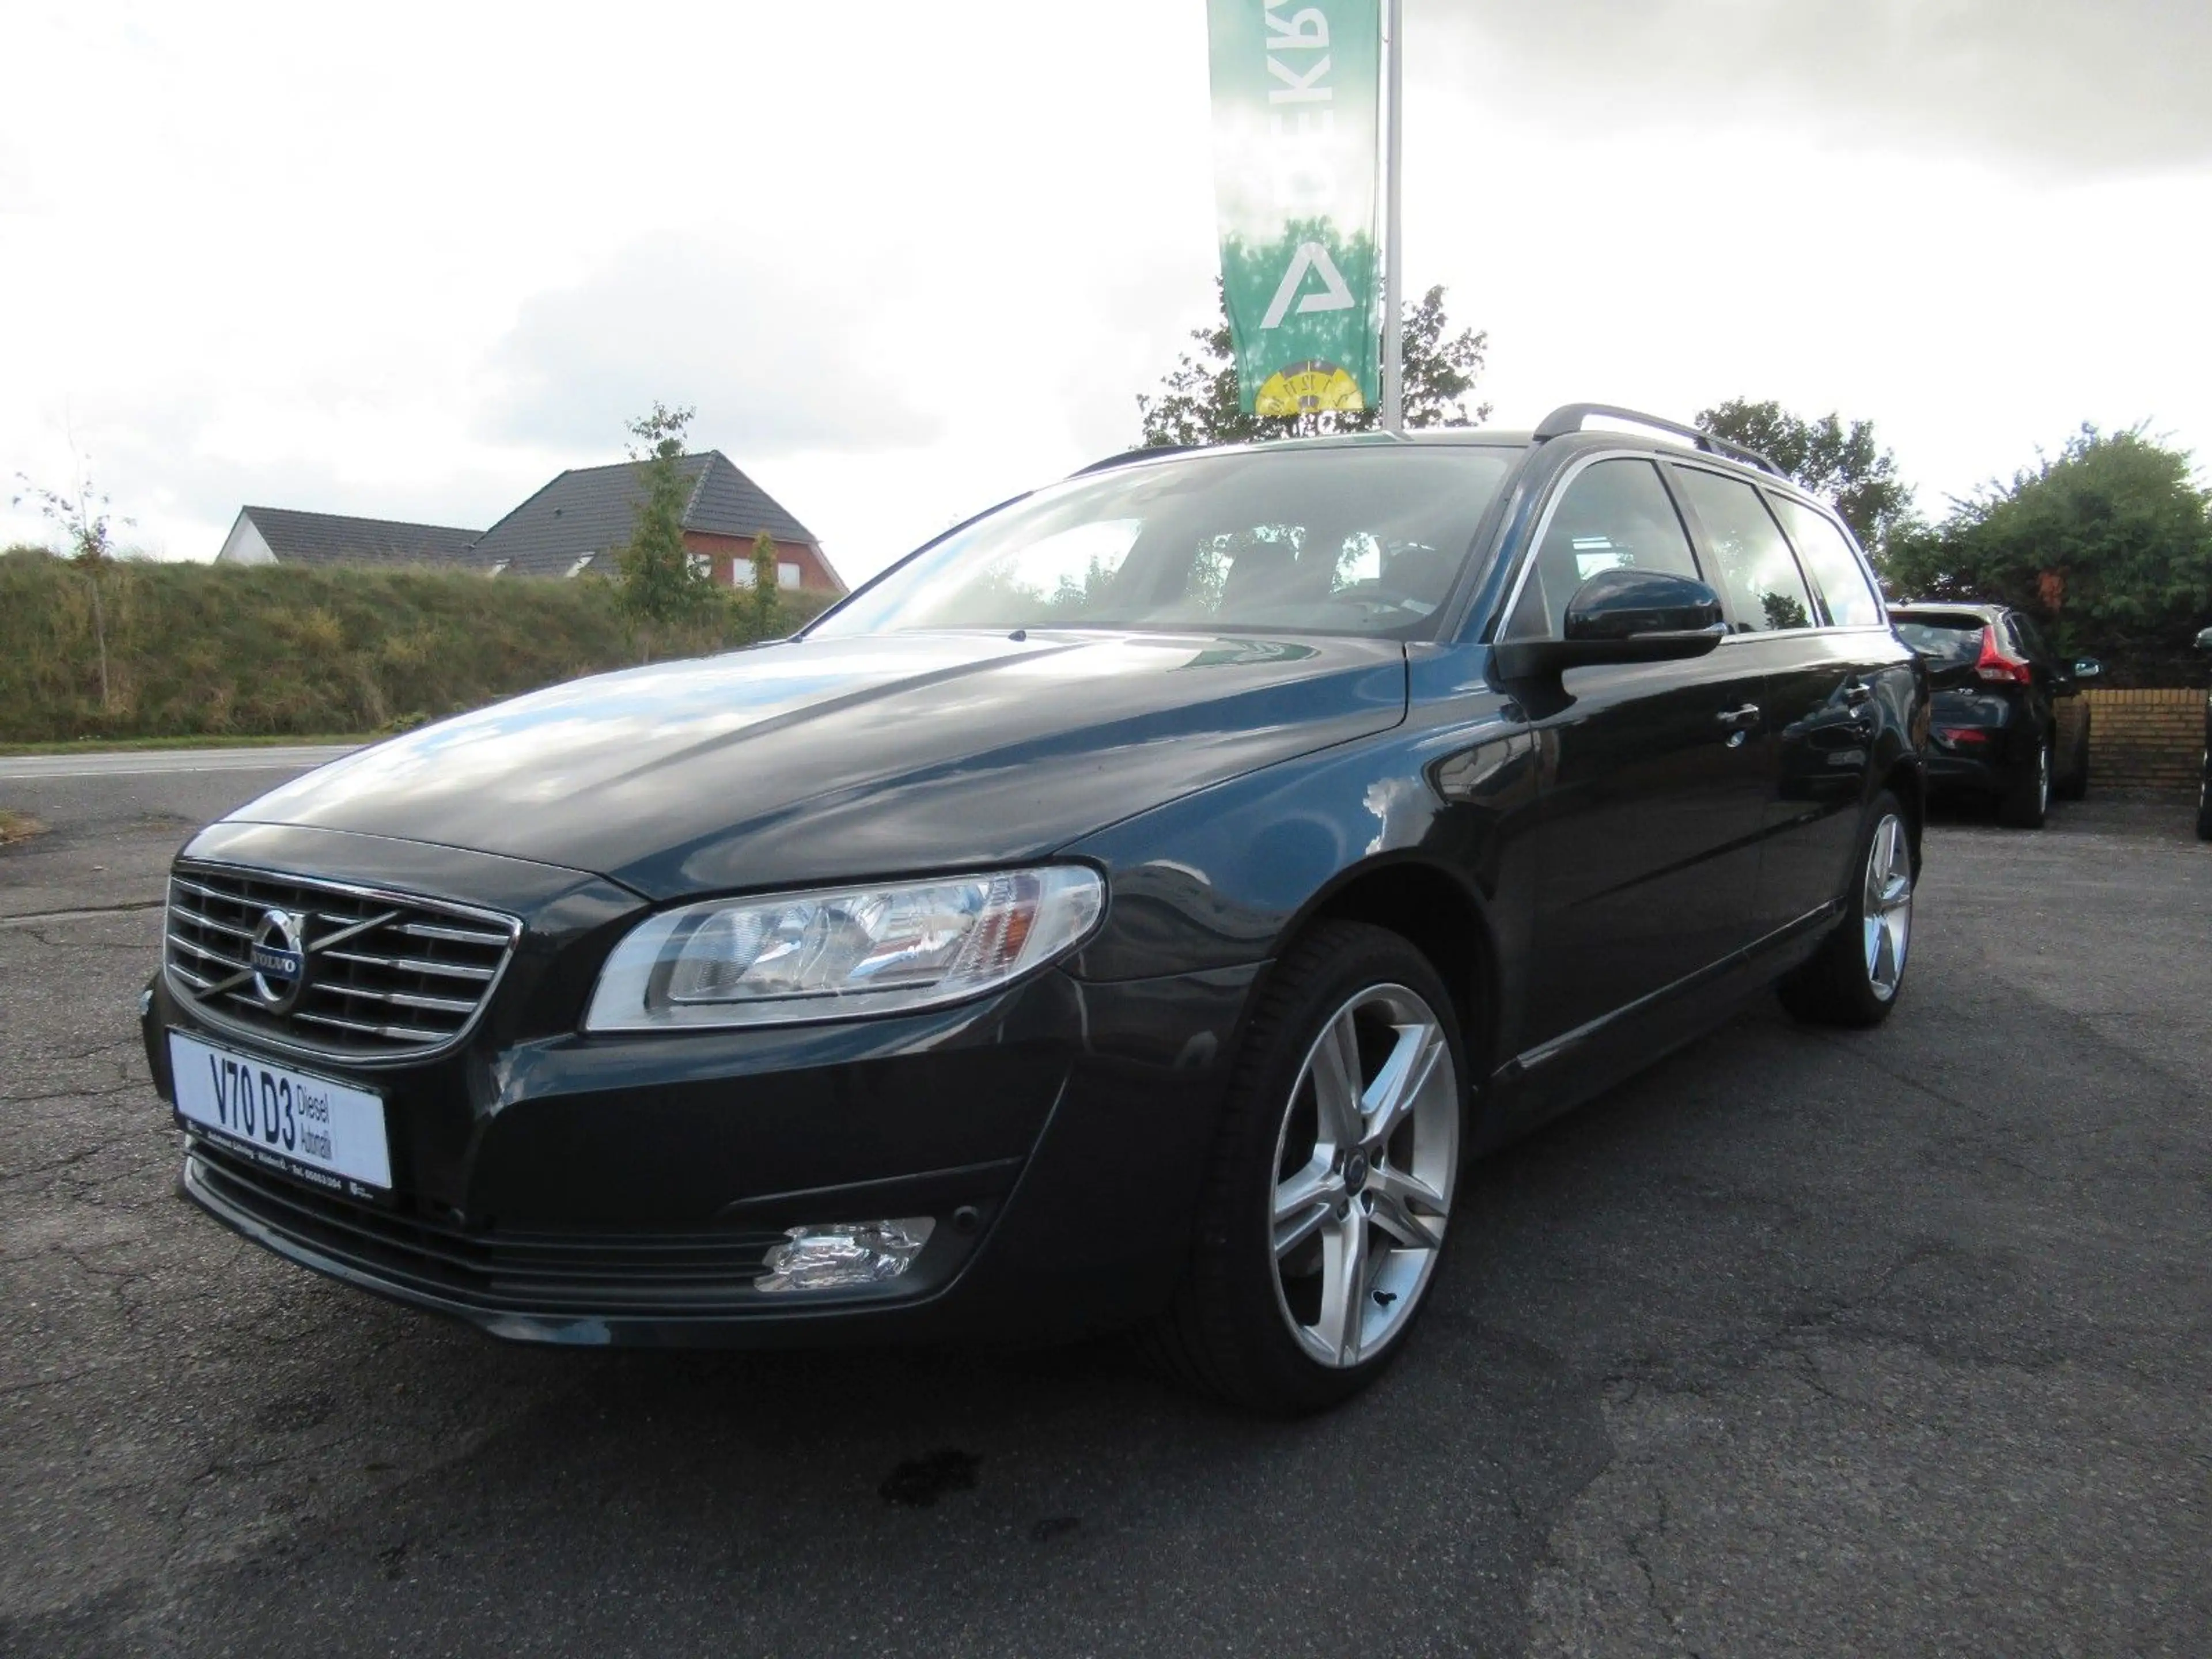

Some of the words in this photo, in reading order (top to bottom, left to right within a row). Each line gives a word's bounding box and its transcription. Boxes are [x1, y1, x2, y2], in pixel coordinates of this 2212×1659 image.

[252, 951, 297, 973] VOLVO
[209, 1054, 255, 1137] V70
[260, 1071, 296, 1152] D3
[297, 1084, 329, 1124] Diesel
